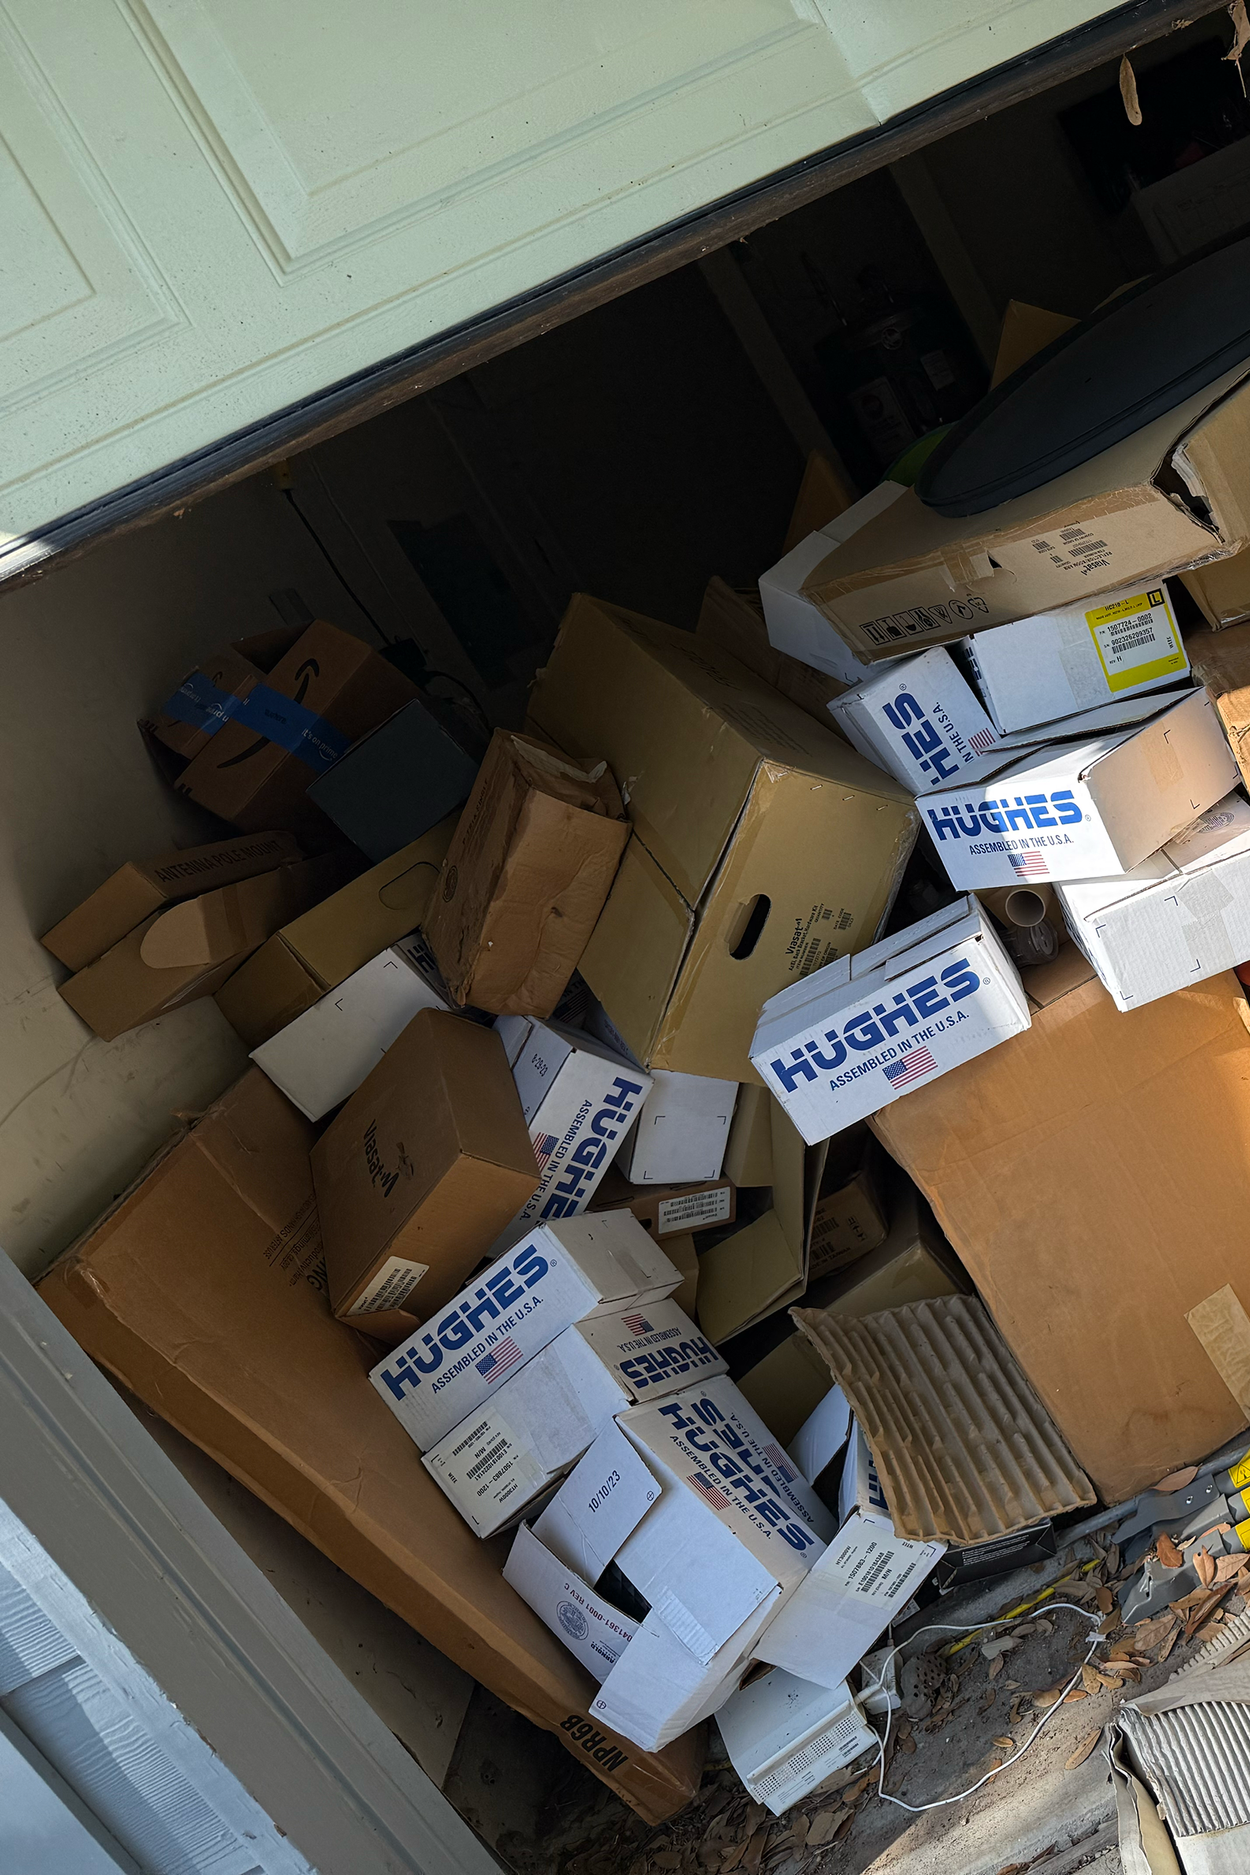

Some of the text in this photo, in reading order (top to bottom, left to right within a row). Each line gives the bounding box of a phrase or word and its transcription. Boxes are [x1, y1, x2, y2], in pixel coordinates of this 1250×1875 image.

[1151, 591, 1160, 603] L
[310, 736, 321, 746] on
[317, 740, 340, 760] prime
[882, 692, 960, 786] HES
[932, 701, 974, 763] N THE U.S.A.
[927, 790, 1083, 841] HUGHES
[154, 839, 283, 883] ANTENNA POLE MOUNT
[969, 834, 1074, 856] ASSEMBLED IN THE U.S.A.
[785, 925, 804, 956] Viasat
[770, 957, 981, 1093] HUGHES
[830, 1009, 970, 1092] ASSEMBLED IN THE U.S.A.
[363, 1119, 385, 1187] Viasat
[518, 1099, 593, 1222] ASSEMBLED IN THE U.S.A.
[540, 1076, 644, 1220] HUGHE
[261, 1246, 274, 1259] USE
[278, 1218, 297, 1238] HANDS
[380, 1244, 550, 1402] HUGHES
[431, 1295, 545, 1394] ASSEMBLED IN THE U.S.A.
[616, 1325, 681, 1354] ASSEMBLED IN THE U.S.A.
[619, 1336, 719, 1389] HUGHES
[473, 1445, 486, 1458] M/N
[658, 1402, 815, 1552] HUGHES
[726, 1411, 816, 1525] ASSEMBLED IN THE U.S.A.
[585, 1469, 623, 1512] 10/10/23
[670, 1434, 773, 1540] ASSEMBLED IN THE U.S.A.
[562, 1582, 569, 1590] C
[569, 1588, 586, 1605] REV
[881, 1567, 893, 1580] M/N
[562, 1712, 628, 1773] NPR6B
